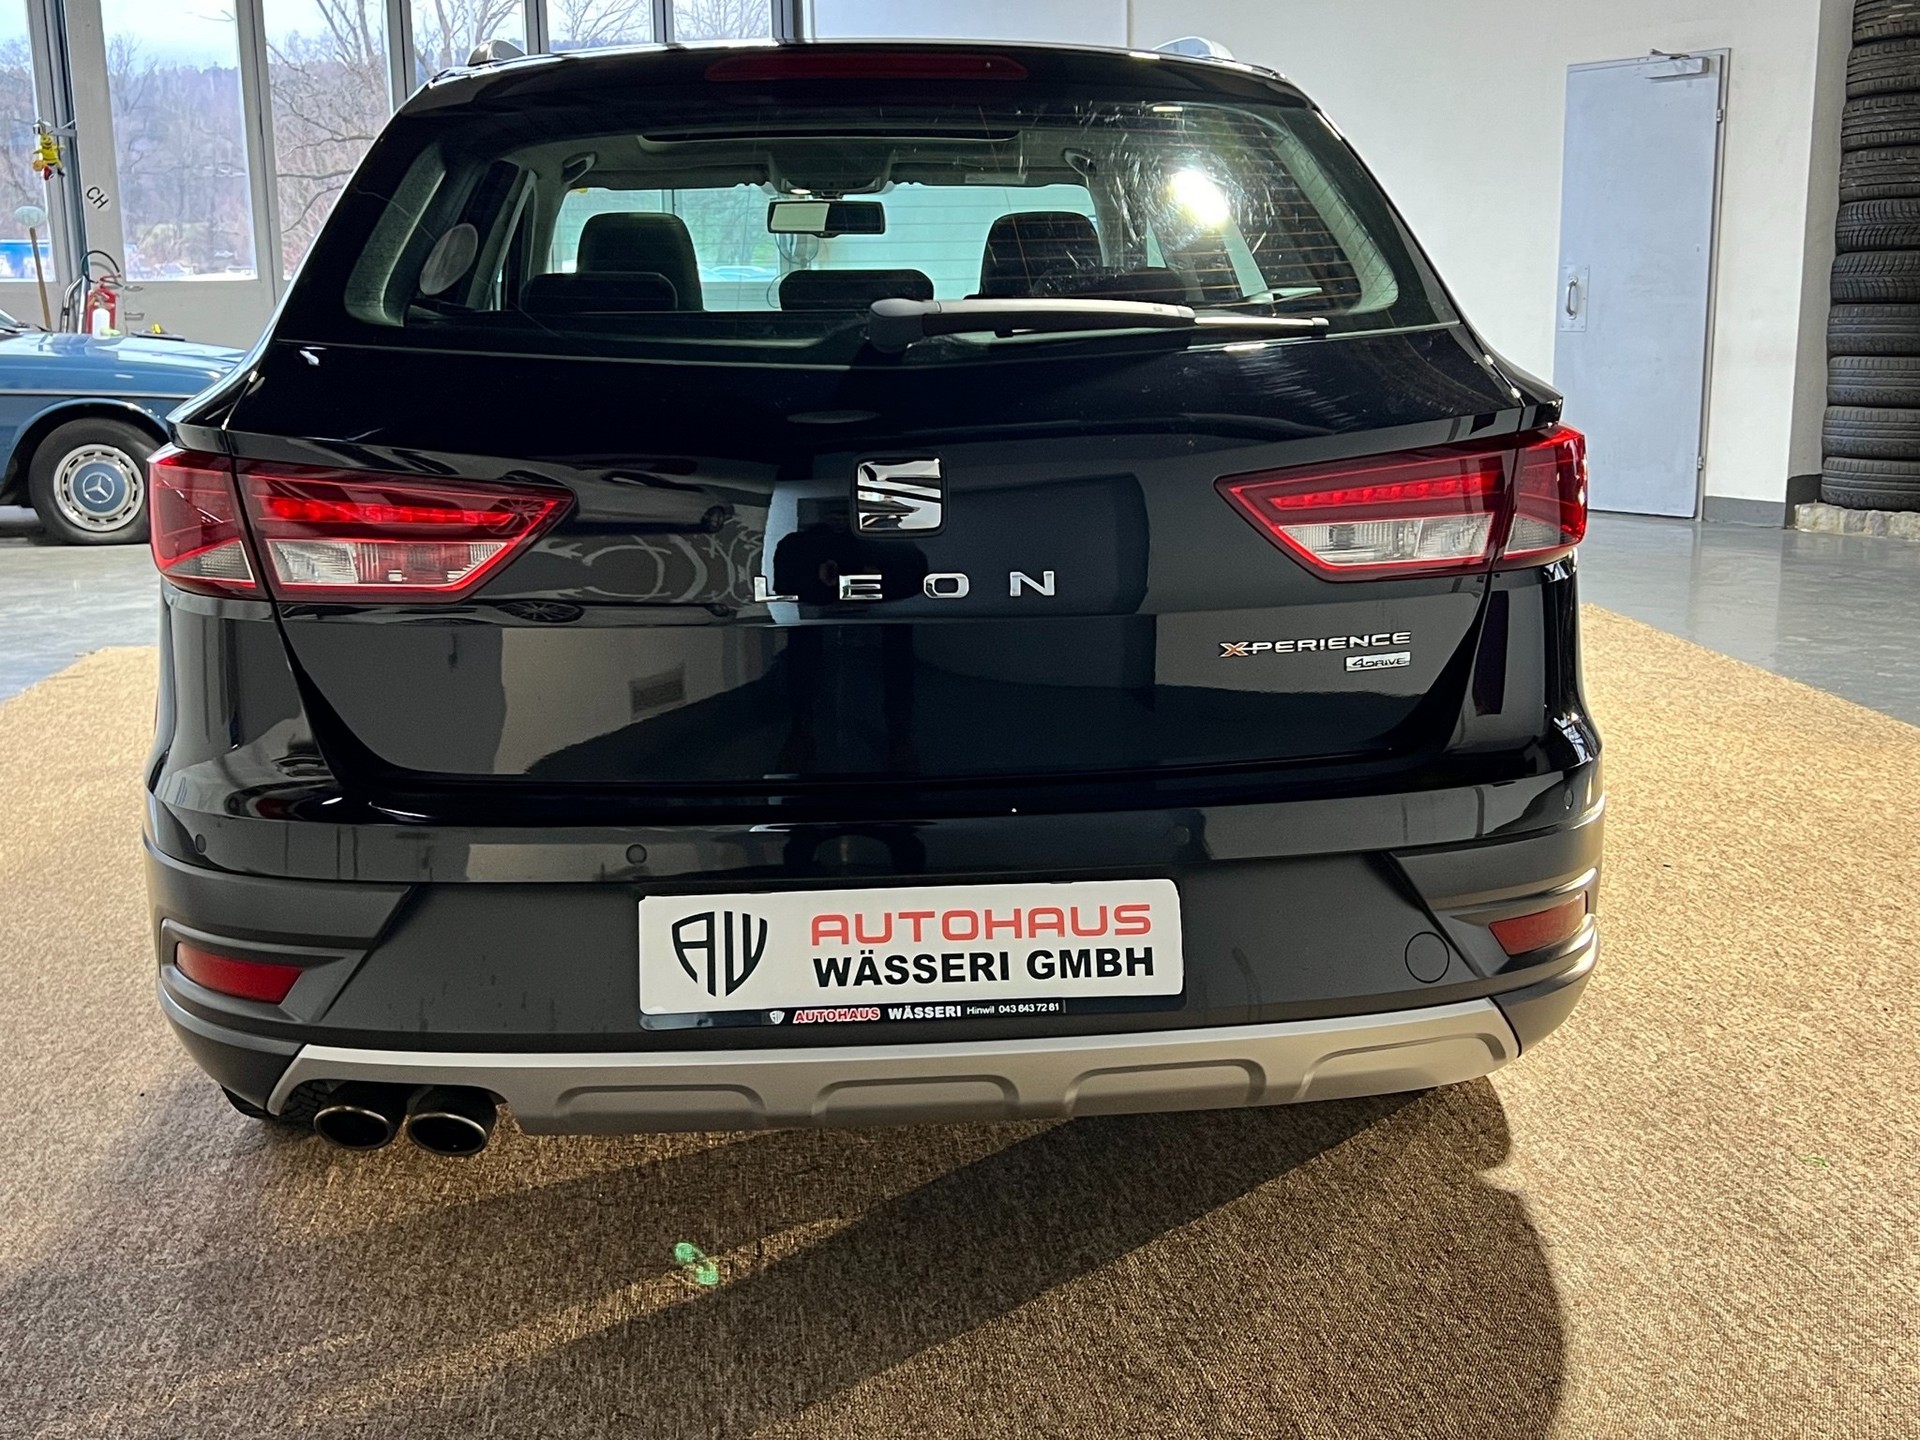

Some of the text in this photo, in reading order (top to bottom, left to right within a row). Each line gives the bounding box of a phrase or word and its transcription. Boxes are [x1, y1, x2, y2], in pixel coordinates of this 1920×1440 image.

[86, 186, 110, 210] CH
[754, 571, 1055, 601] LEON
[810, 904, 1152, 946] AUTOHAUS
[813, 946, 1154, 988] WÄSSERI GMBH
[793, 1007, 881, 1023] AUTOHAUS
[888, 1005, 962, 1020] WÄSSERI
[966, 1005, 995, 1015] Hinwil
[998, 1004, 1017, 1014] 043
[1036, 1003, 1048, 1012] 72
